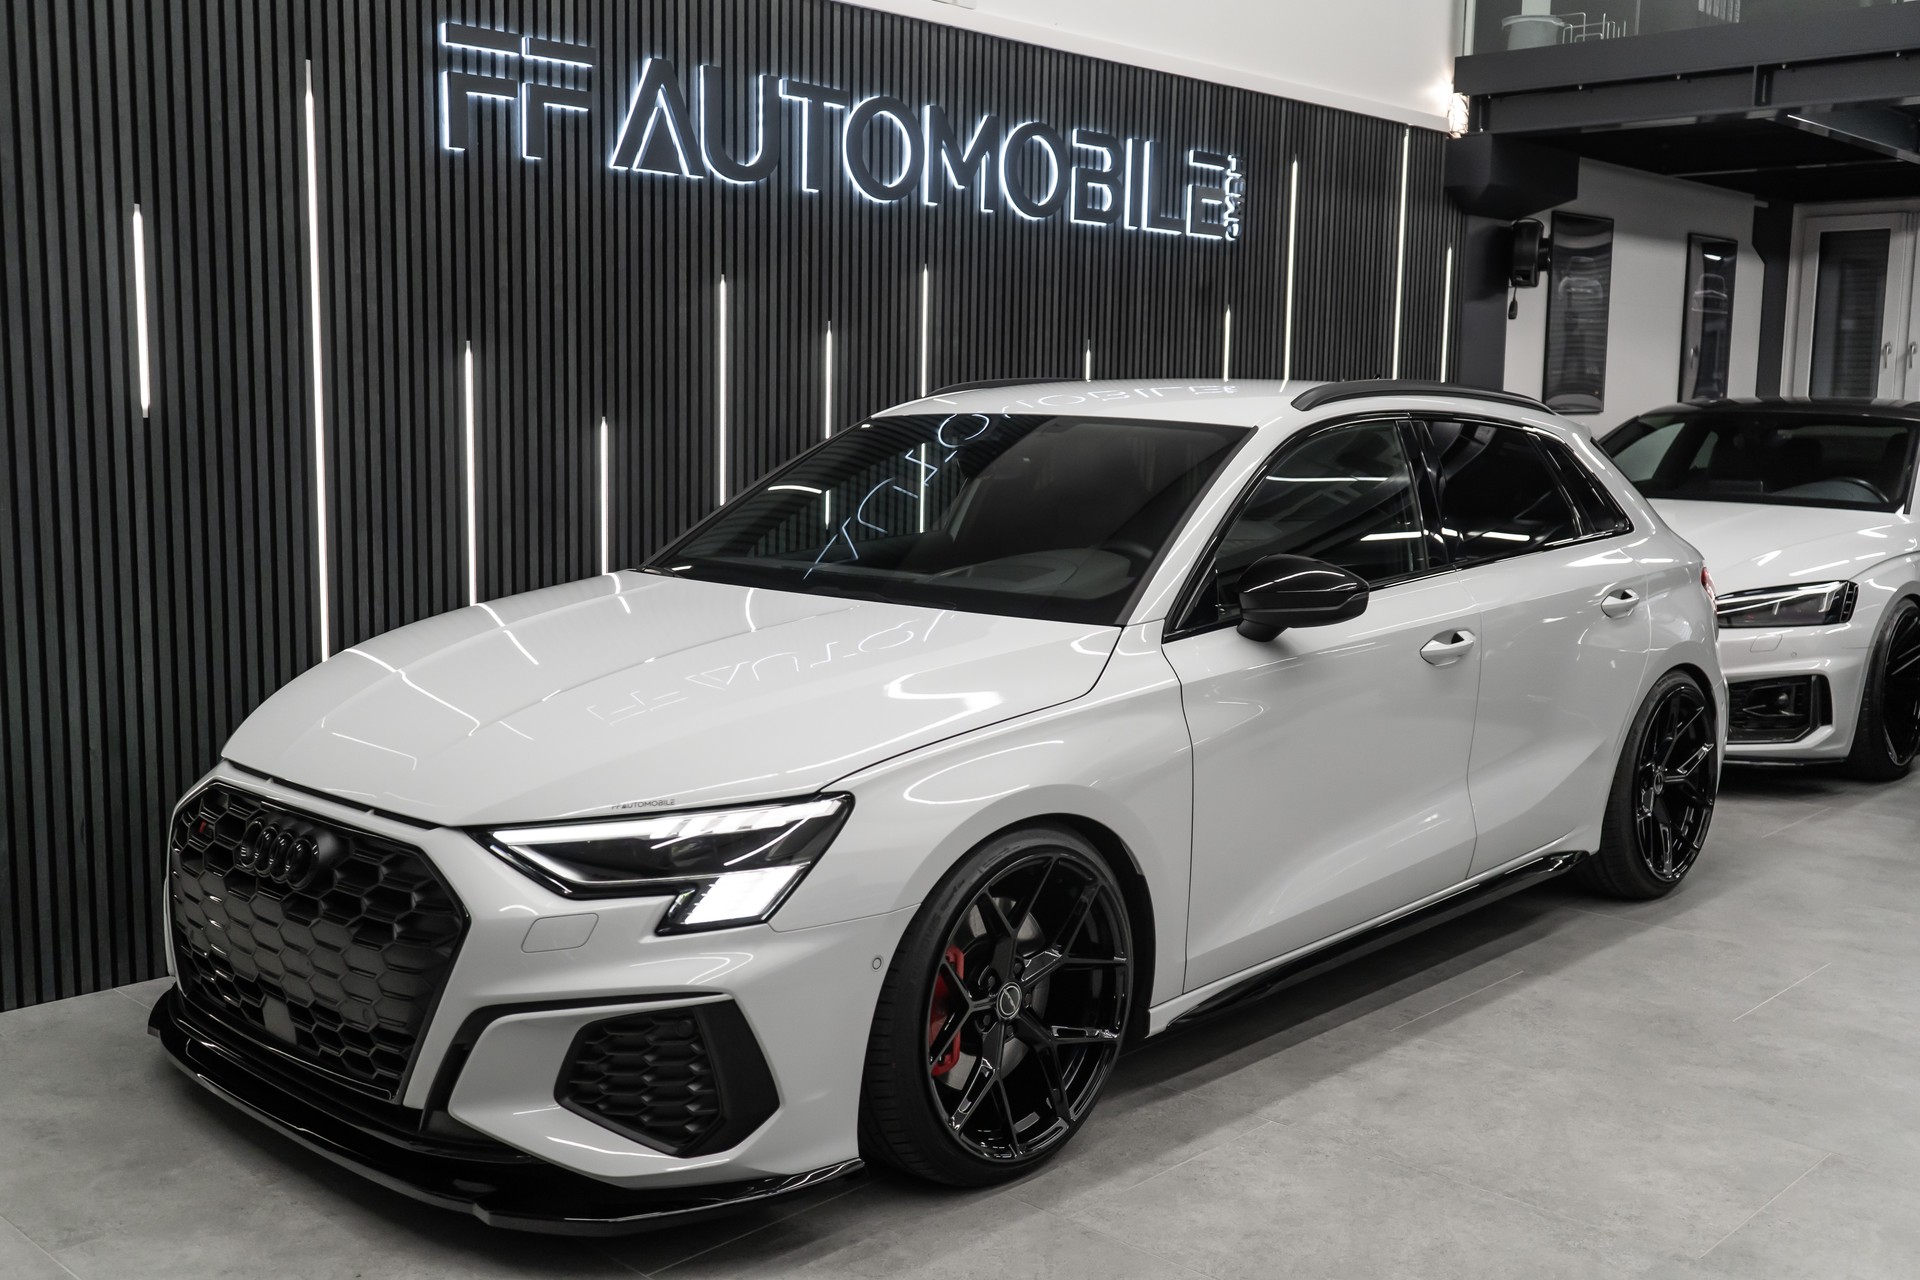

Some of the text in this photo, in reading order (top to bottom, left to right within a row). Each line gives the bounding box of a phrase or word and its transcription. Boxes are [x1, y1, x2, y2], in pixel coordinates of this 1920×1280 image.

[440, 22, 1226, 240] FF AUTOMOBILE
[621, 799, 676, 809] AUTOMOBILE
